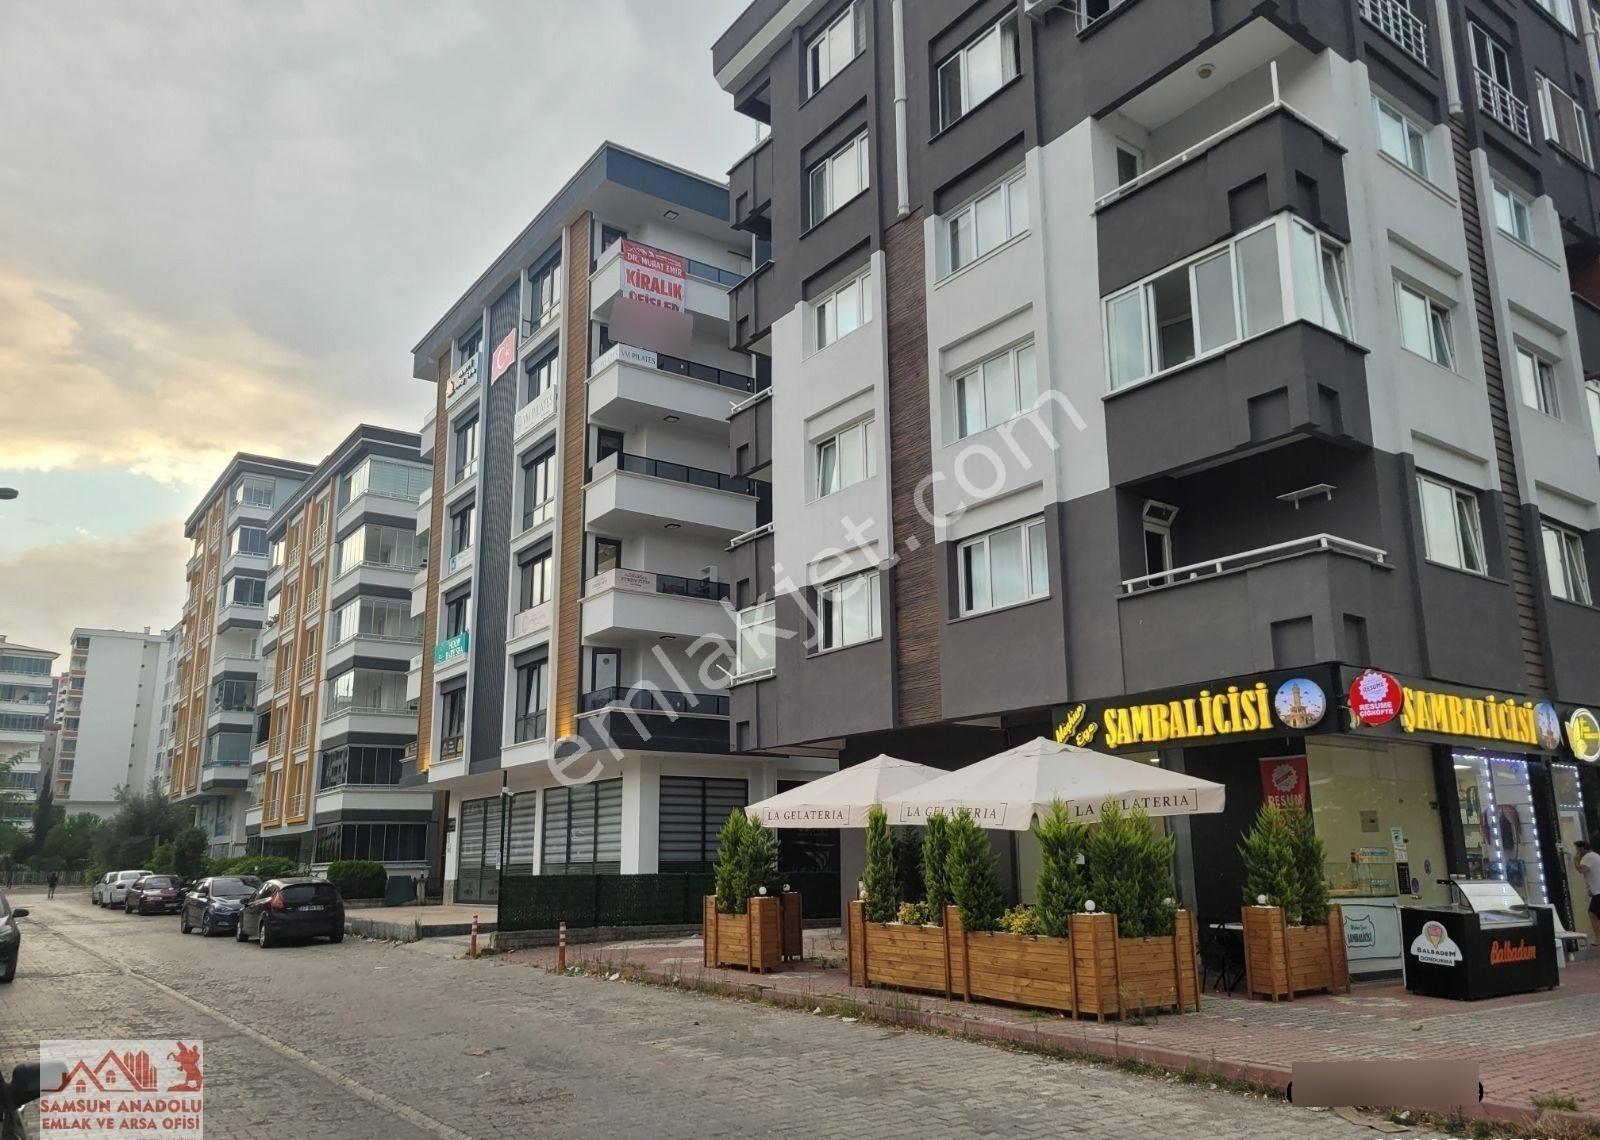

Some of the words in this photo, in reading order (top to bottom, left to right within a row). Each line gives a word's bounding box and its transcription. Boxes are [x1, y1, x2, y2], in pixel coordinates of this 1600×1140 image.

[625, 268, 683, 300] KİRALIK
[1103, 681, 1274, 750] ŞAMBALİCİSİ
[1401, 686, 1539, 745] ŞAMBALİCİSİ
[1076, 722, 1097, 747] Ege
[768, 811, 780, 821] LA
[783, 810, 844, 820] GELATERIA
[907, 806, 921, 817] LA
[1076, 804, 1094, 817] LA
[1491, 938, 1537, 965] Balbadem
